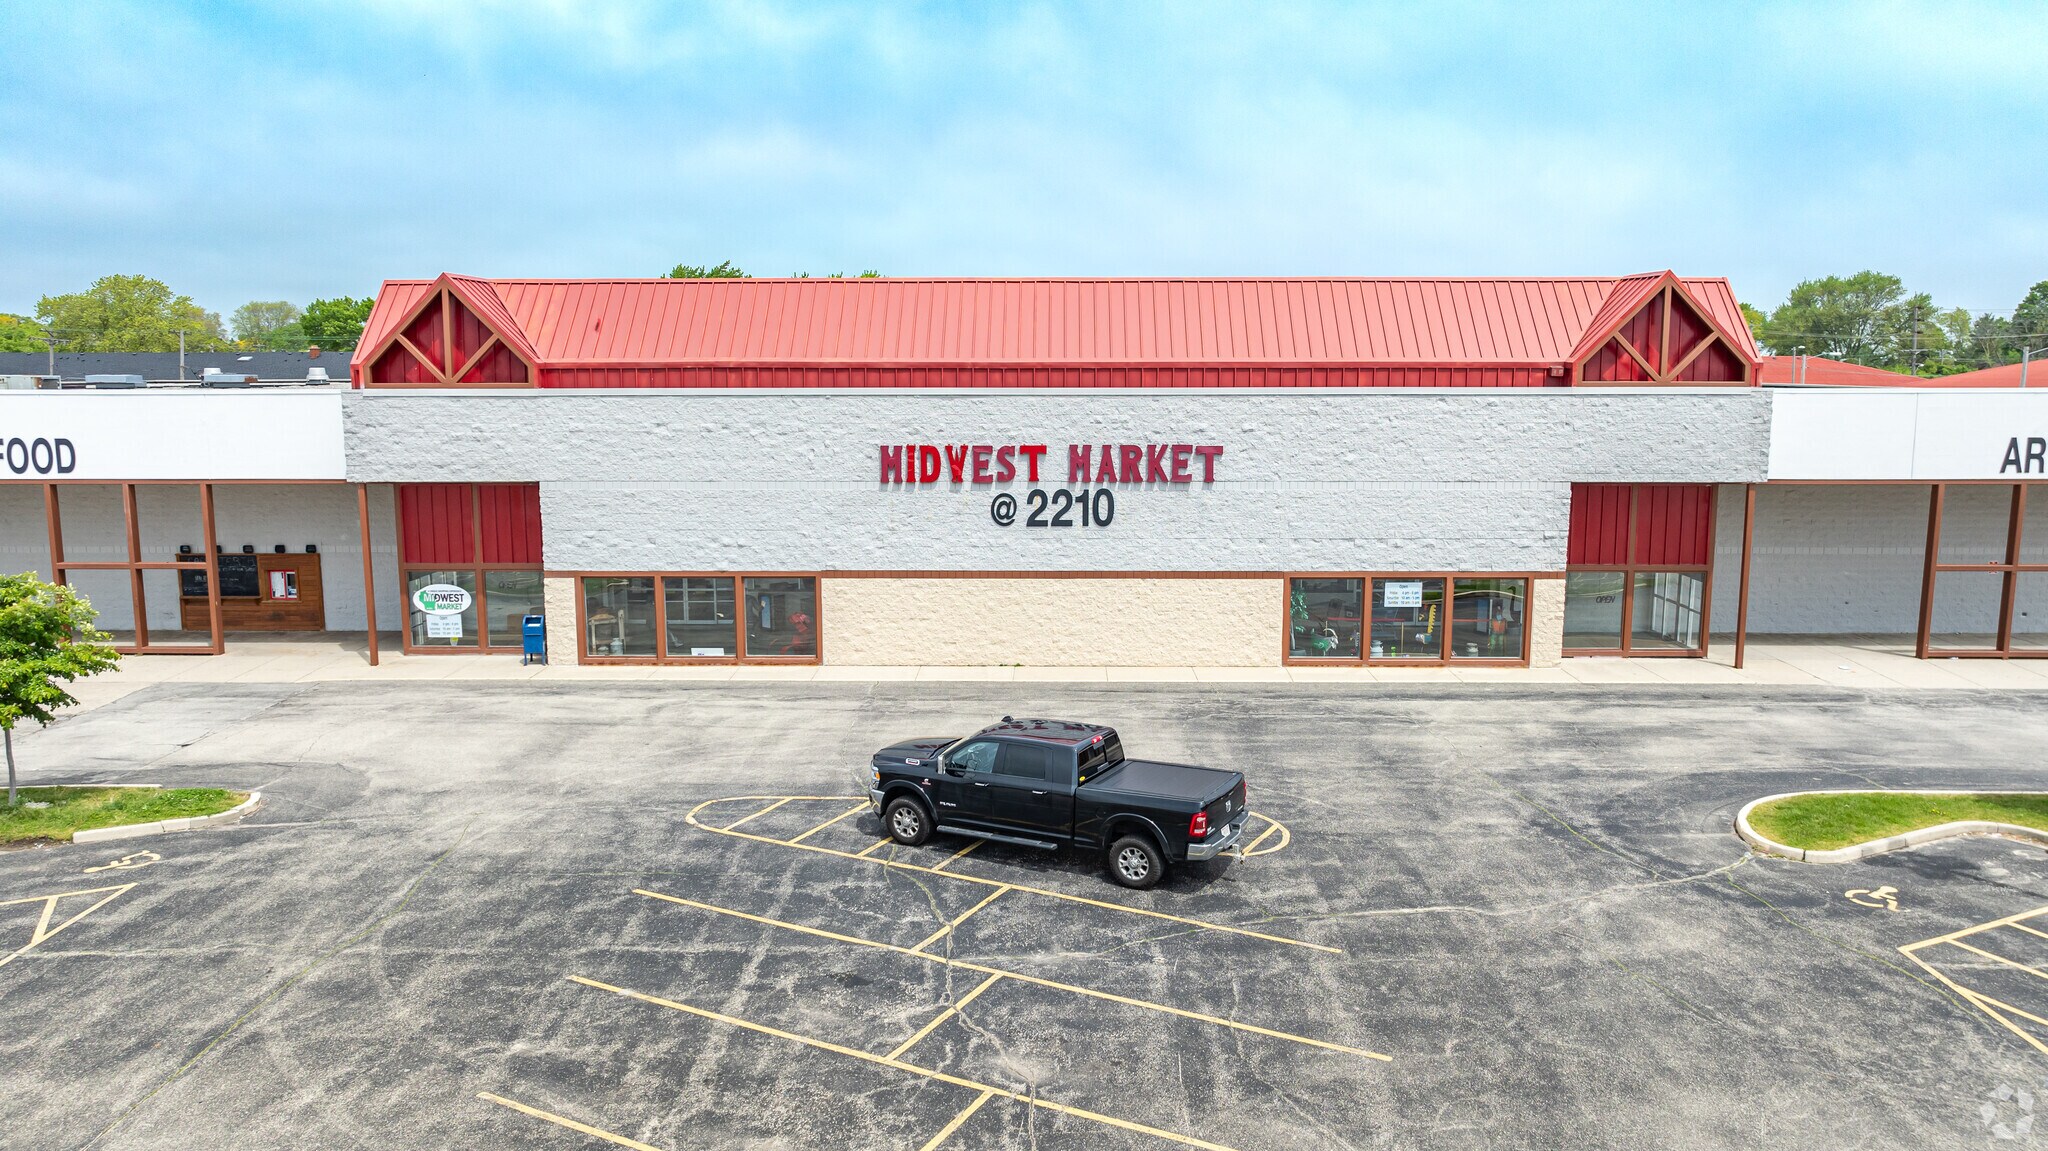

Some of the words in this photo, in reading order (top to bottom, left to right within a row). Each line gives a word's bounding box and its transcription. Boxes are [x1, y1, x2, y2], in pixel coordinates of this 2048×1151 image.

[880, 444, 1047, 483] MIDWEST
[1068, 444, 1223, 483] MARKET
[991, 493, 1017, 527] @
[1026, 488, 1114, 527] 2210
[423, 593, 464, 602] MIDWEST
[1595, 595, 1615, 603] OPEN
